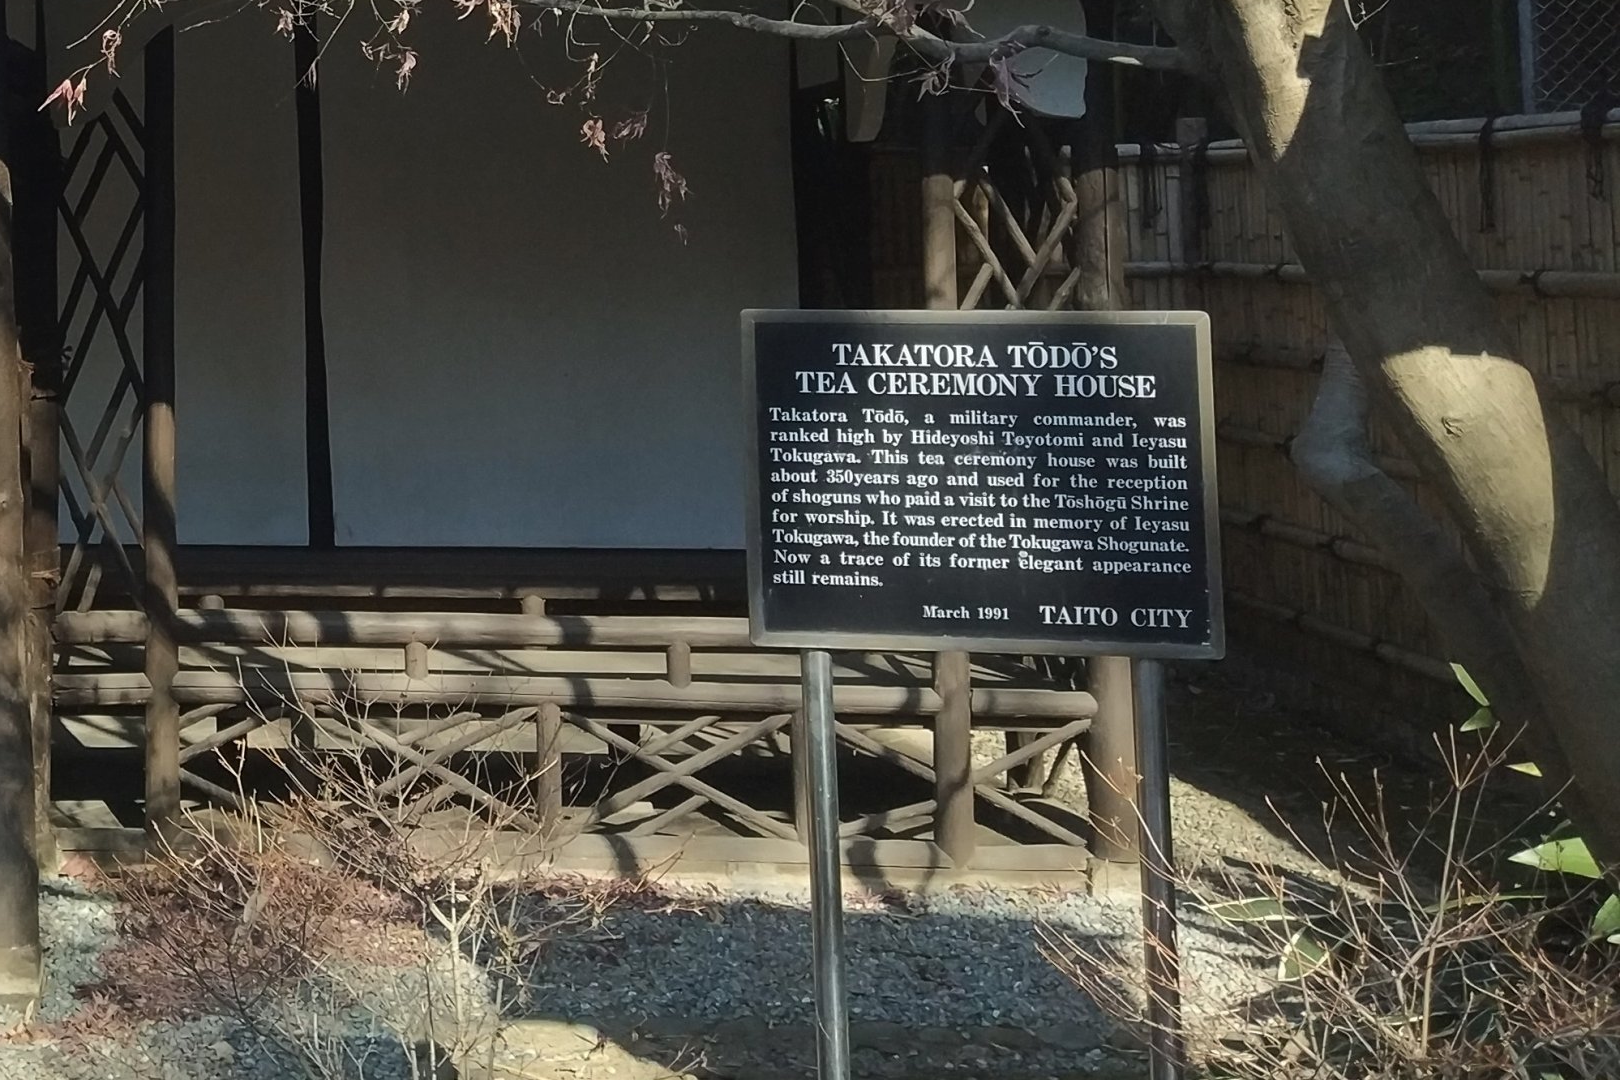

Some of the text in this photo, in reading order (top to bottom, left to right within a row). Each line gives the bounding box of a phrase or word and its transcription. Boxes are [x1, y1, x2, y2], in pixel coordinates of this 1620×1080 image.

[832, 343, 998, 368] TAKATORA
[795, 371, 1156, 398] TEA CEREMONY HOUSE
[769, 407, 848, 422] Takatora
[924, 413, 935, 424] a
[949, 410, 1018, 428] military
[1033, 412, 1137, 429] commander,
[1153, 417, 1186, 428] was
[770, 427, 1187, 450] ranked high by Hideyoshi Toyotomi and Ieyasu
[770, 447, 1187, 469] Tokugawa. This tea ceremony house was built
[771, 468, 1188, 492] about 350years ago and used for the reception
[771, 488, 789, 502] of
[792, 488, 861, 506] shoguns
[865, 489, 901, 505] who
[904, 490, 941, 508] paid
[944, 495, 955, 506] a
[958, 491, 996, 507] visit
[999, 493, 1018, 508] to
[1021, 493, 1050, 508] the
[1131, 495, 1189, 510] Shrine
[772, 508, 1189, 533] for worship. It was erected in memory of Ieyasu
[772, 527, 1189, 554] Tokugawa, the founder of the Tokugawa Shogunate.
[774, 549, 1191, 574] Now a trace of its former elegant appearance
[773, 569, 883, 587] still remains.
[923, 605, 1192, 628] March 1991 TAITO CITY
